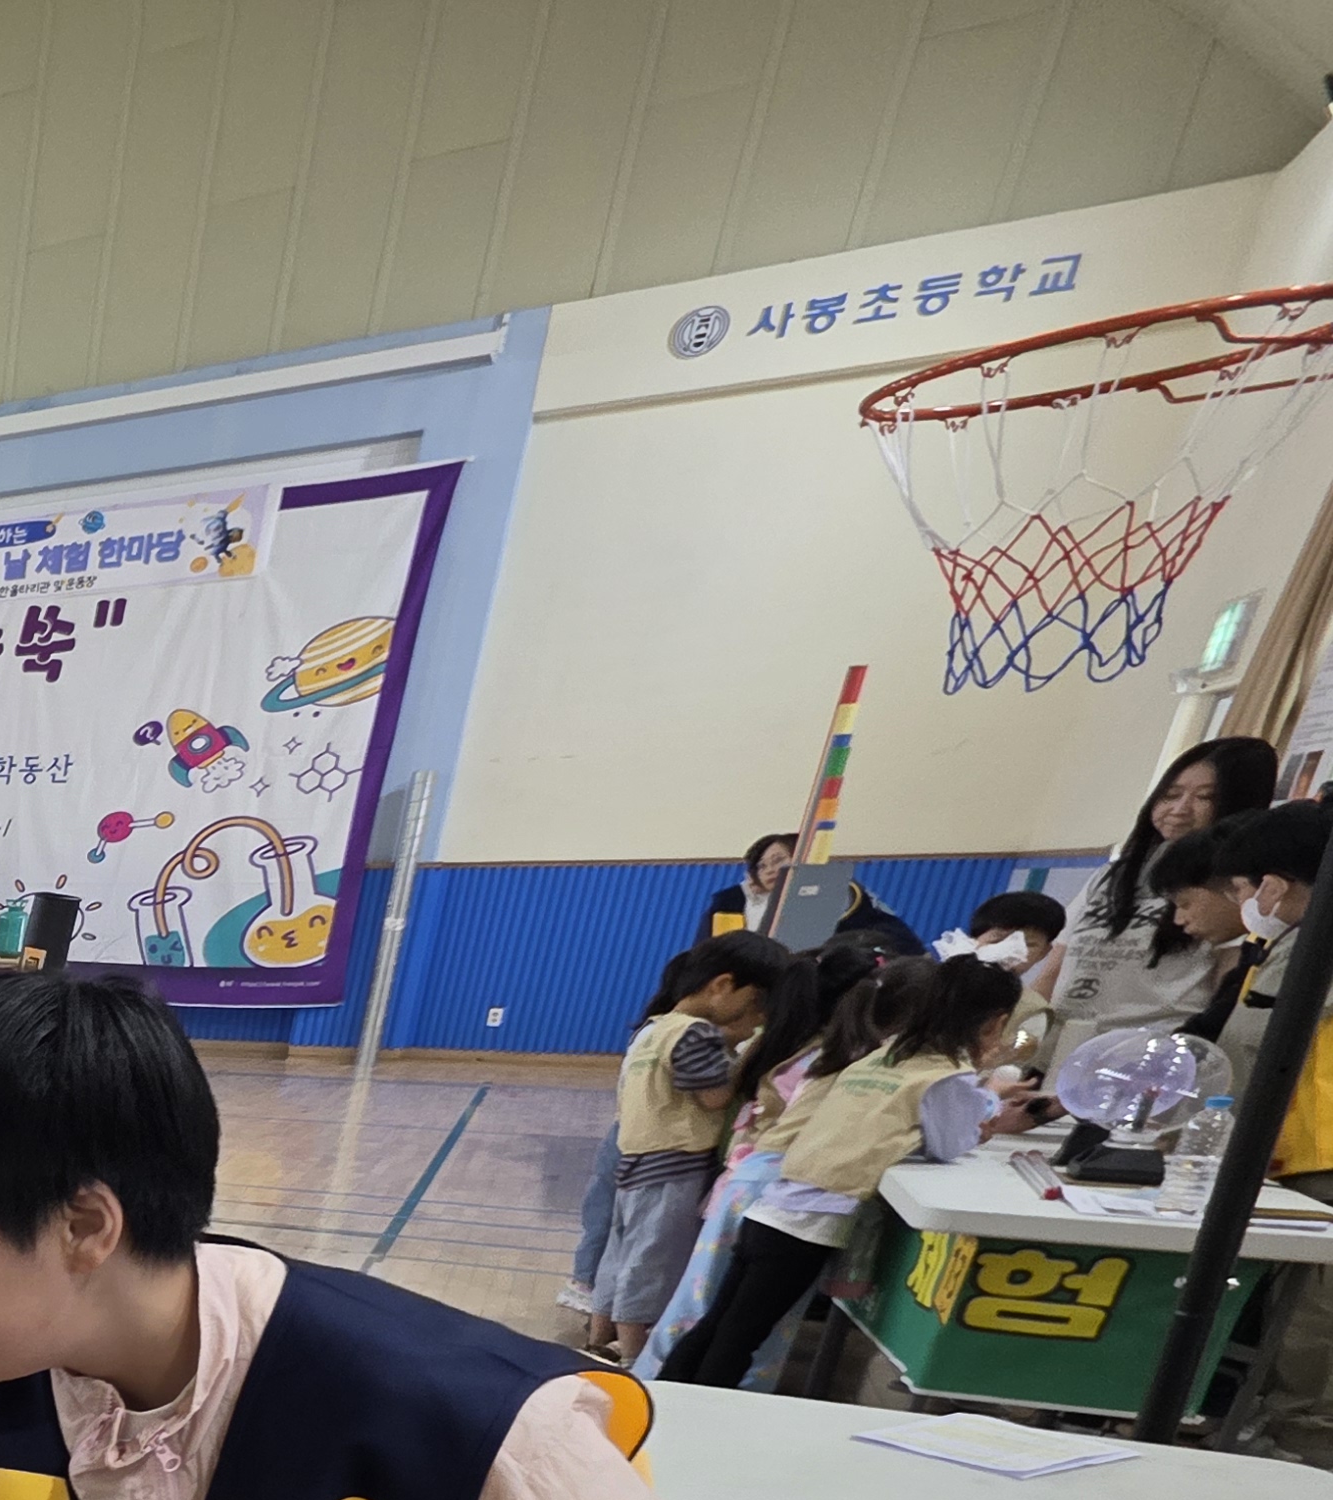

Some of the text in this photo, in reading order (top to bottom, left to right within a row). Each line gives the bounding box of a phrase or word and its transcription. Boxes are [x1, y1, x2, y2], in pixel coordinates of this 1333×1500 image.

[746, 253, 1083, 338] 사봉초등학교
[3, 549, 31, 581] 날
[35, 540, 92, 575] 체험
[98, 529, 186, 569] 한마당
